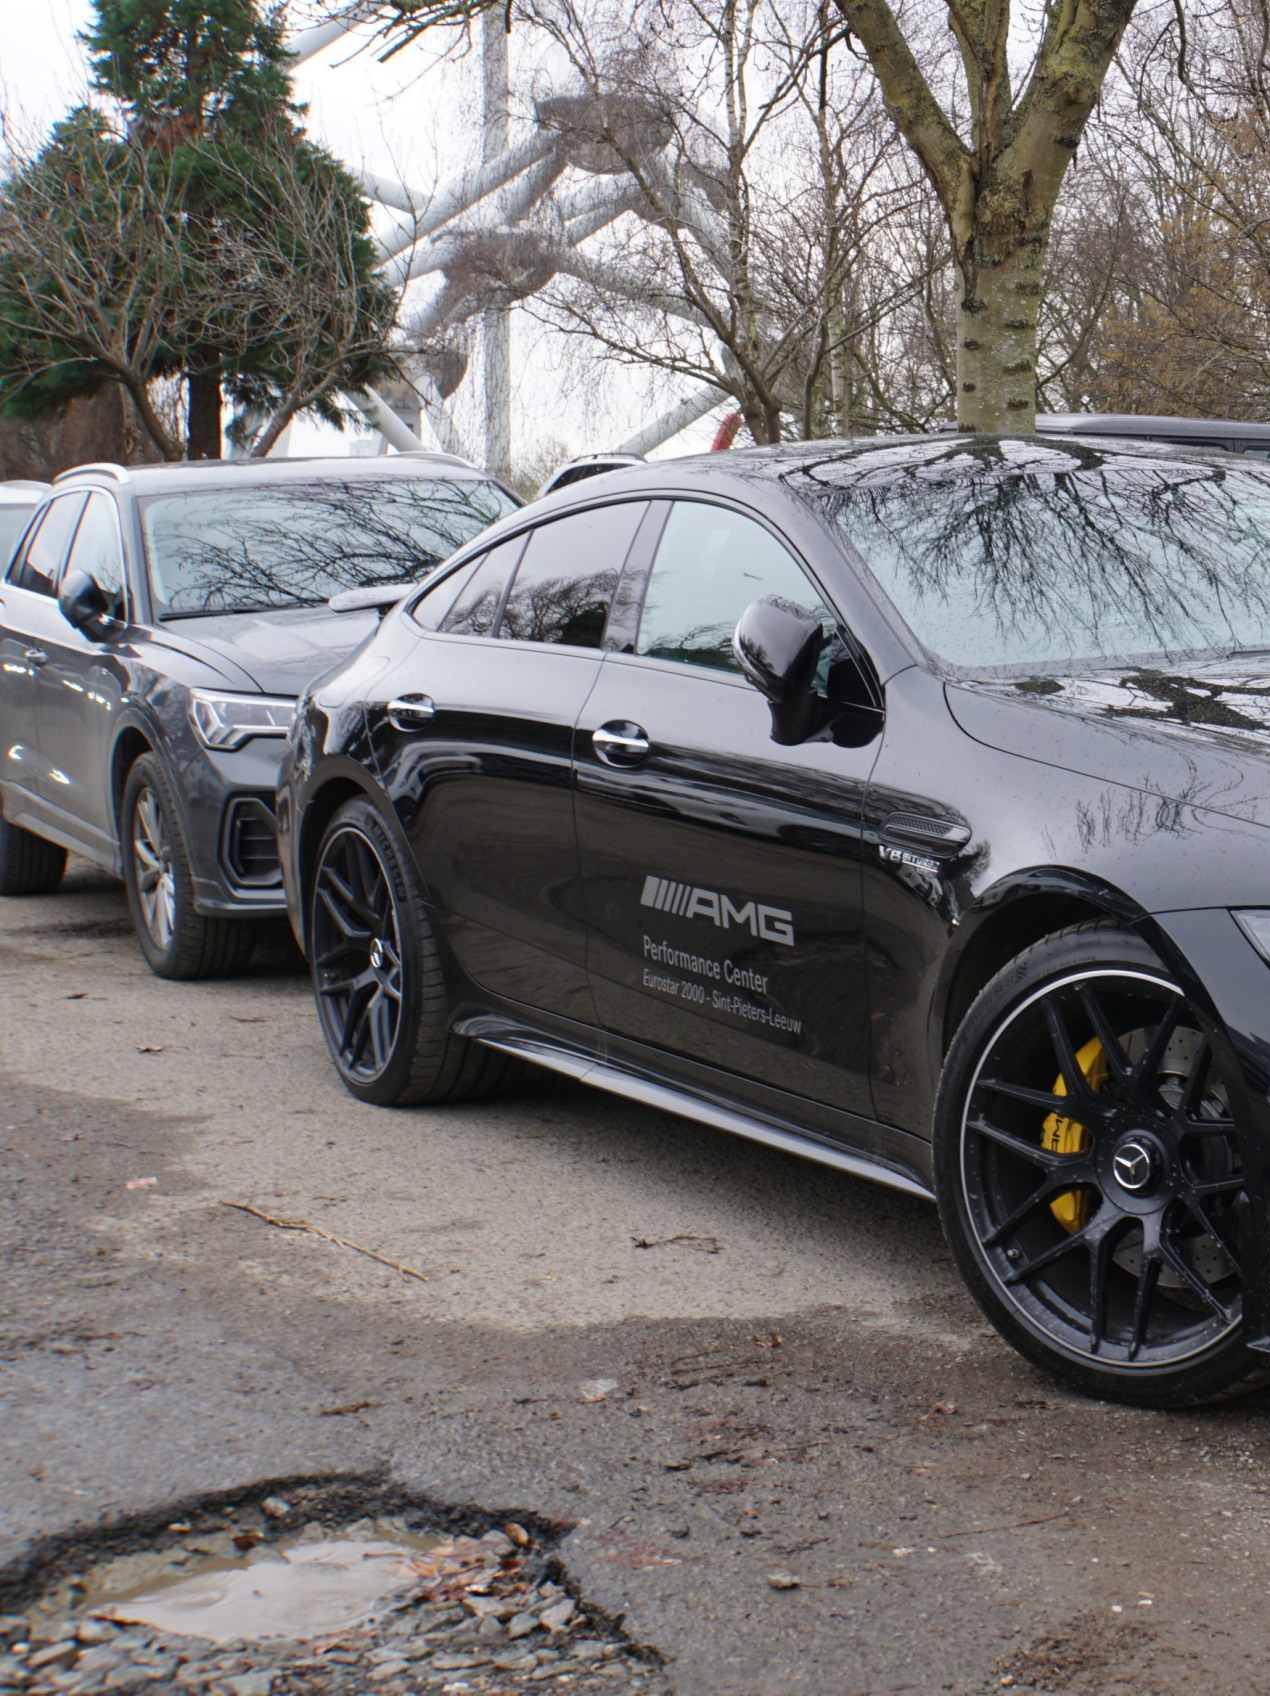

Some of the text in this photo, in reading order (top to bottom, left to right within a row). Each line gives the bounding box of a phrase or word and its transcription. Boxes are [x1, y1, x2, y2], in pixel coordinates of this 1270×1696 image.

[879, 845, 901, 863] V8
[685, 887, 795, 947] AMG
[643, 935, 768, 994] Performance Center
[643, 969, 680, 995] Eurostar
[681, 980, 705, 1003] 2000
[712, 990, 802, 1034] Sint-Pieters-Leeuw
